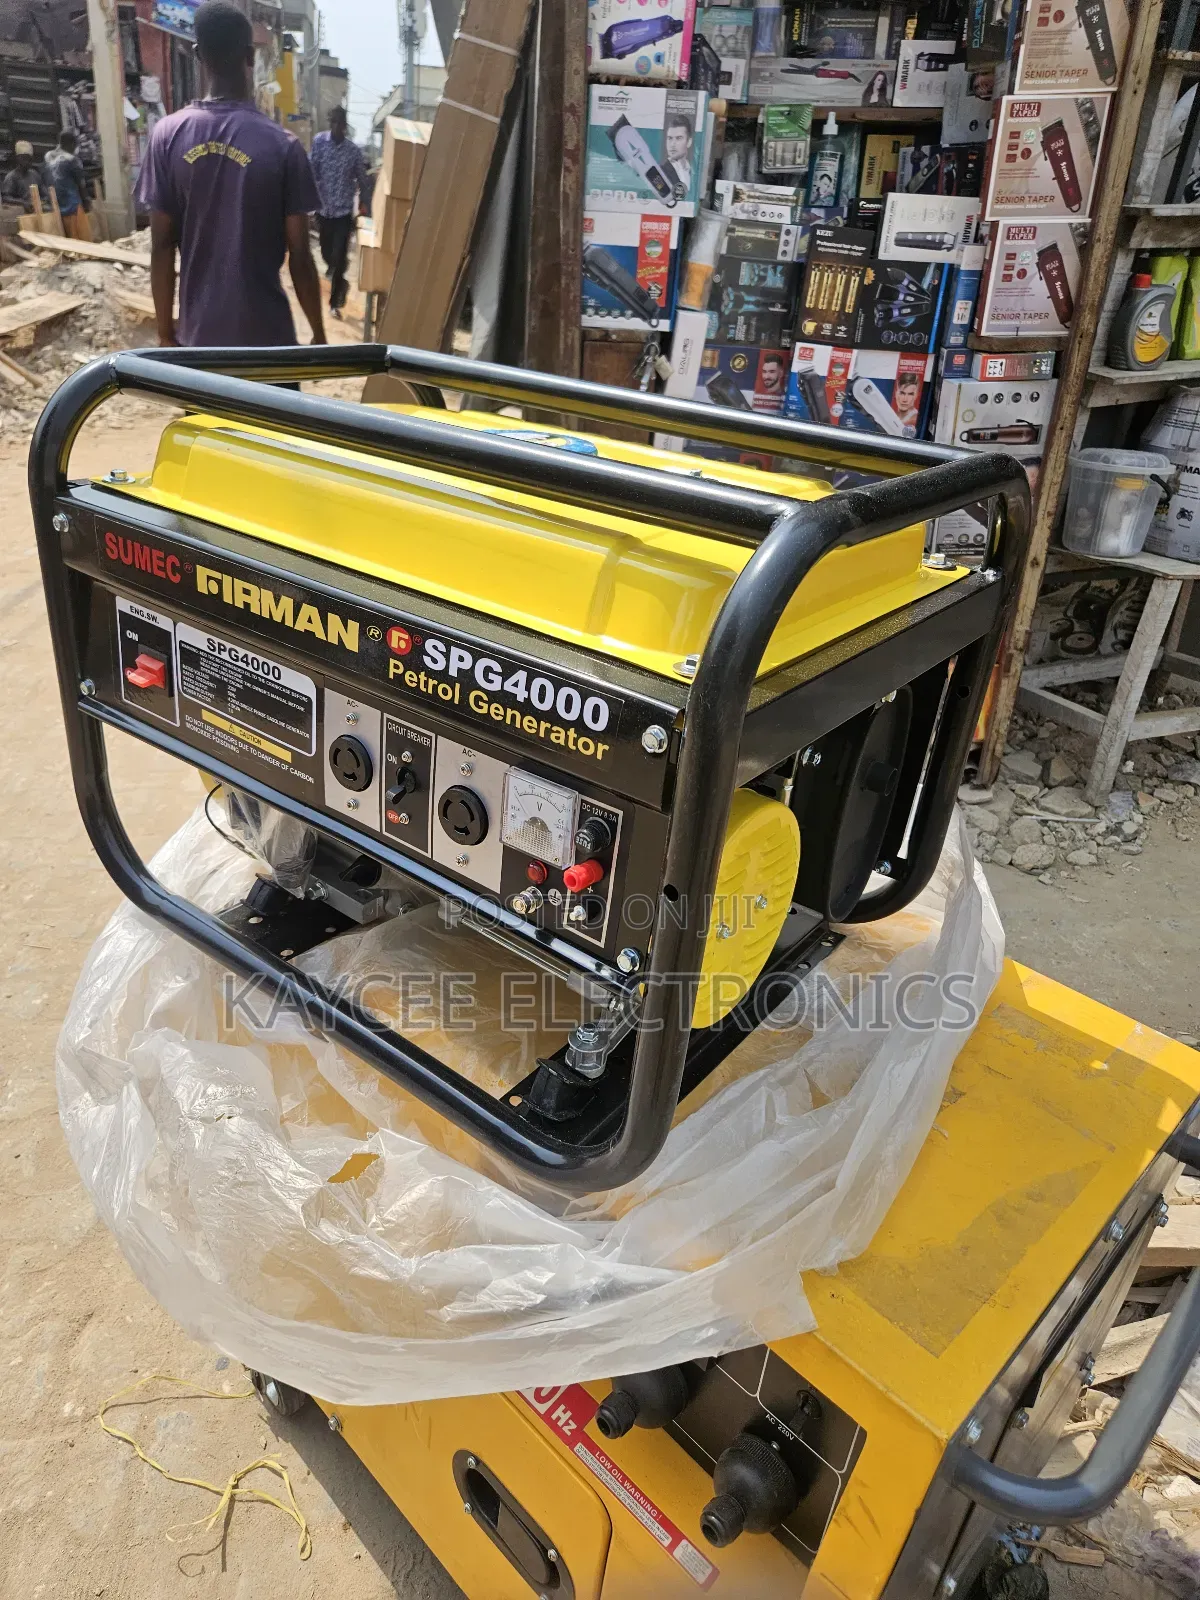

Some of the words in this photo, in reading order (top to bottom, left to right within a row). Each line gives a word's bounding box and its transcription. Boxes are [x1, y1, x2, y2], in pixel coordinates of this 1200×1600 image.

[900, 59, 910, 90] WMARK
[1024, 69, 1057, 79] SENIOR
[1060, 68, 1088, 77] TAPER
[865, 156, 876, 185] WMARK
[995, 196, 1025, 204] SENIOR
[1028, 195, 1055, 203] TAPER
[962, 215, 974, 243] WMAR
[105, 532, 181, 584] SUMEC
[196, 565, 359, 653] FIRMAN
[130, 605, 159, 624] ENG.SW.
[126, 630, 138, 641] ON
[206, 638, 281, 680] SPG4000
[423, 639, 609, 732] SPG4000
[388, 658, 460, 704] Petrol
[469, 690, 610, 761] Generator
[185, 721, 211, 739] MONOXIDE
[212, 734, 239, 754] POISONING
[240, 729, 262, 746] CAUTION
[388, 722, 406, 736] CIRCUIT
[407, 730, 431, 748] BREAKER
[185, 714, 192, 724] DO
[193, 718, 204, 729] NOT
[204, 723, 214, 734] USE
[238, 740, 249, 752] DUE
[250, 746, 257, 756] TO
[257, 750, 280, 767] DANGER
[281, 761, 288, 771] OF
[289, 765, 314, 784] CARBON
[387, 753, 397, 764] ON
[388, 813, 398, 821] OFF
[537, 801, 542, 811] V
[582, 802, 591, 812] DC
[592, 807, 603, 816] 12V
[576, 836, 591, 849] FUSE
[551, 1404, 577, 1436] Hz
[766, 1414, 775, 1424] AC
[778, 1424, 794, 1440] 220V
[594, 1451, 613, 1469] LOW
[610, 1467, 625, 1483] OIL
[621, 1480, 659, 1517] WARNING
[607, 1476, 624, 1492] WITHOUT
[622, 1491, 641, 1510] CHECKING
[644, 1514, 657, 1527] LEVEL
[654, 1531, 665, 1542] LAMP
